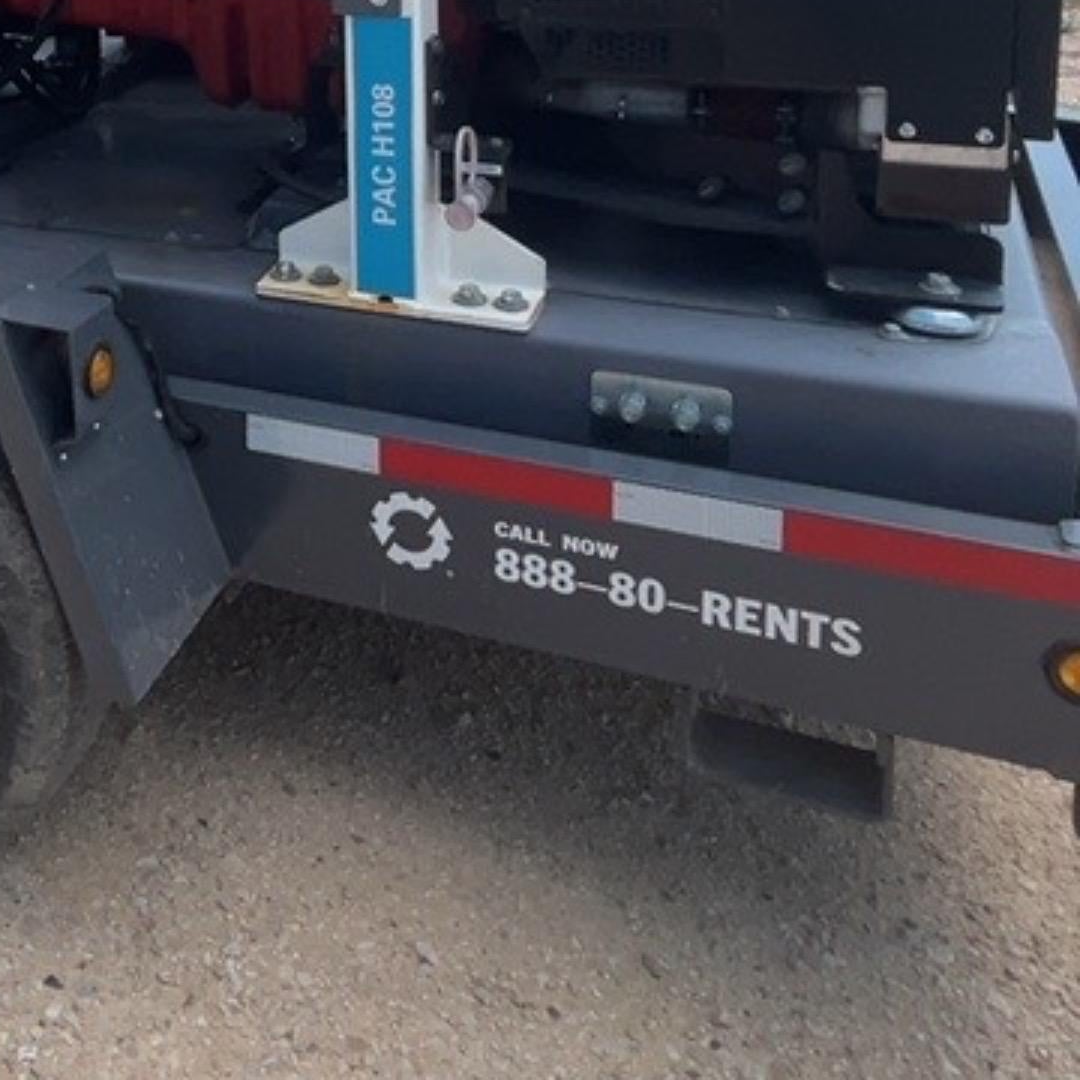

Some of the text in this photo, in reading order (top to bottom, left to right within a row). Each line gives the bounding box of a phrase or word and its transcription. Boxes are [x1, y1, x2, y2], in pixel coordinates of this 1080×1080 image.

[372, 83, 397, 227] PAC H108
[494, 521, 619, 561] CALL NOW
[494, 548, 863, 657] 888-80-RENTS
